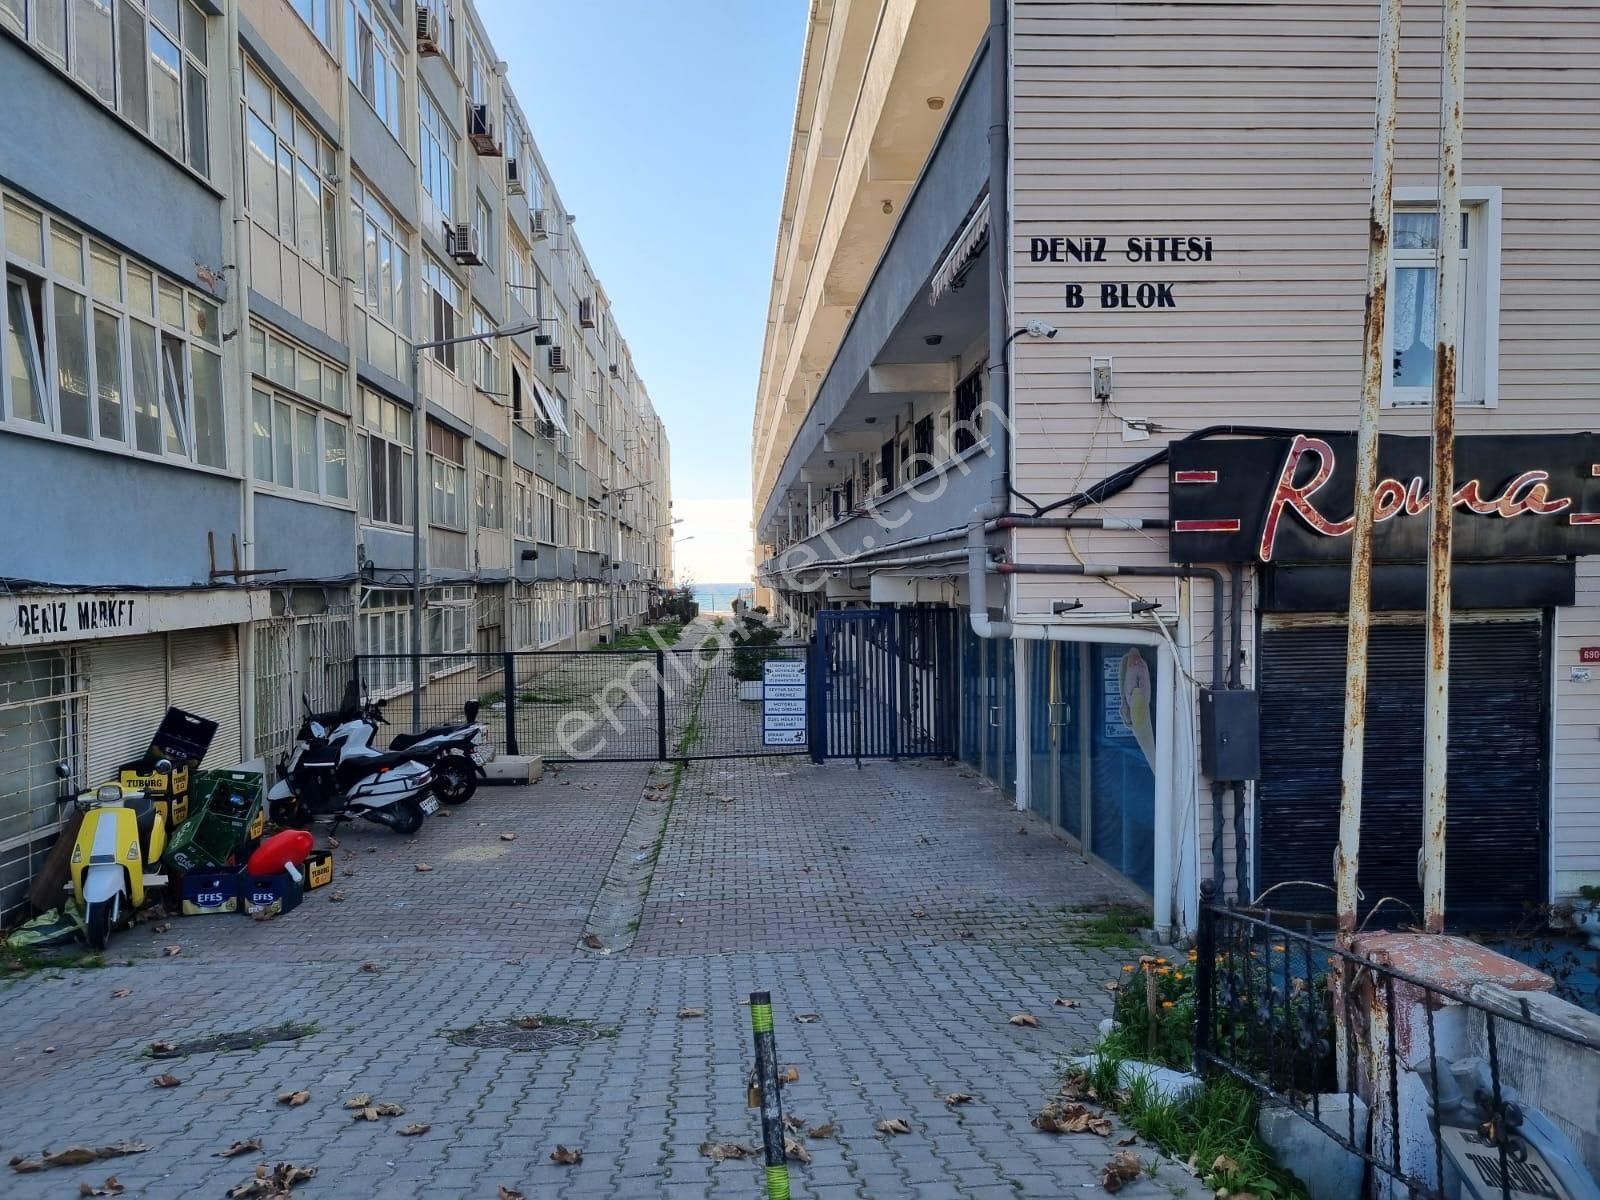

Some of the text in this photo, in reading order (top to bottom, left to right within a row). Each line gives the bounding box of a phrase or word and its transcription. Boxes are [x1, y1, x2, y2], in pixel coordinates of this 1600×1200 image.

[1031, 237, 1107, 263] DENİZ
[1066, 283, 1176, 308] B BLOK
[126, 779, 162, 788] TUBORG
[197, 892, 223, 903] EFES
[253, 893, 274, 901] EFES
